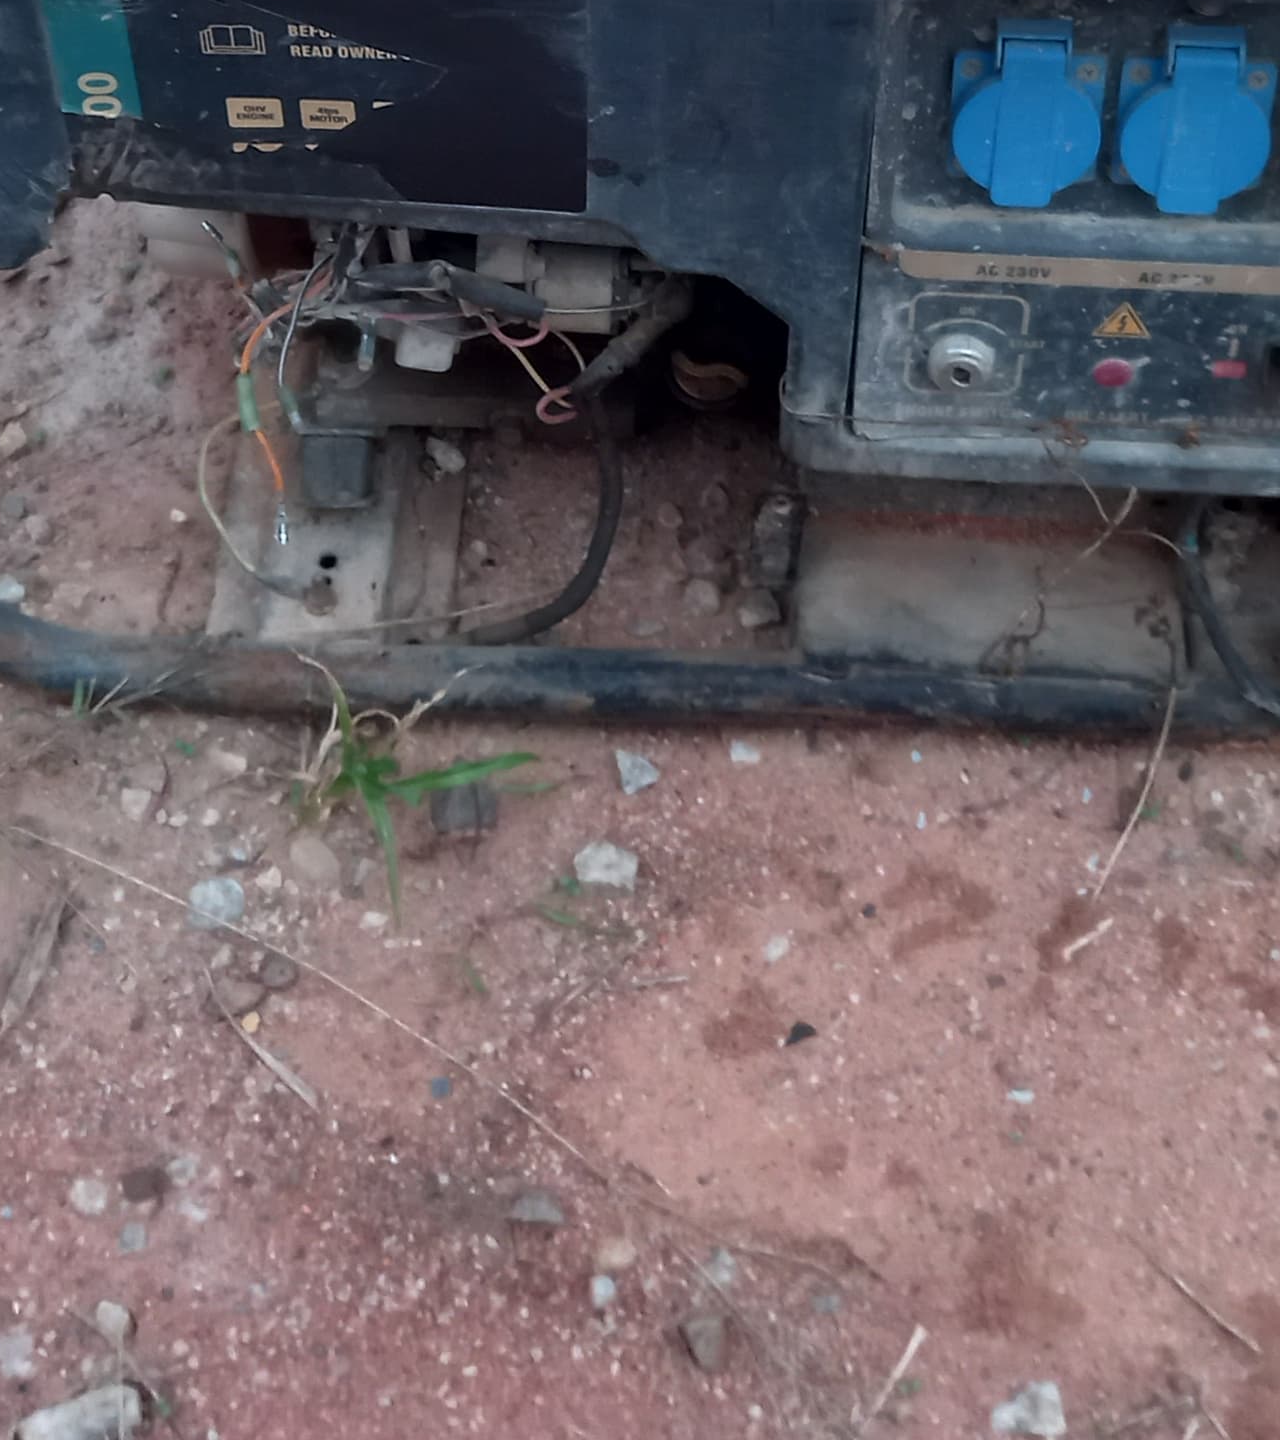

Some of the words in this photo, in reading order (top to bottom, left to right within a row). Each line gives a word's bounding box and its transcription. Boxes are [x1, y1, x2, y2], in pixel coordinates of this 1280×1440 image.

[289, 44, 333, 58] READ
[976, 264, 999, 277] AC
[1005, 265, 1052, 279] 230V
[1138, 271, 1162, 285] AC
